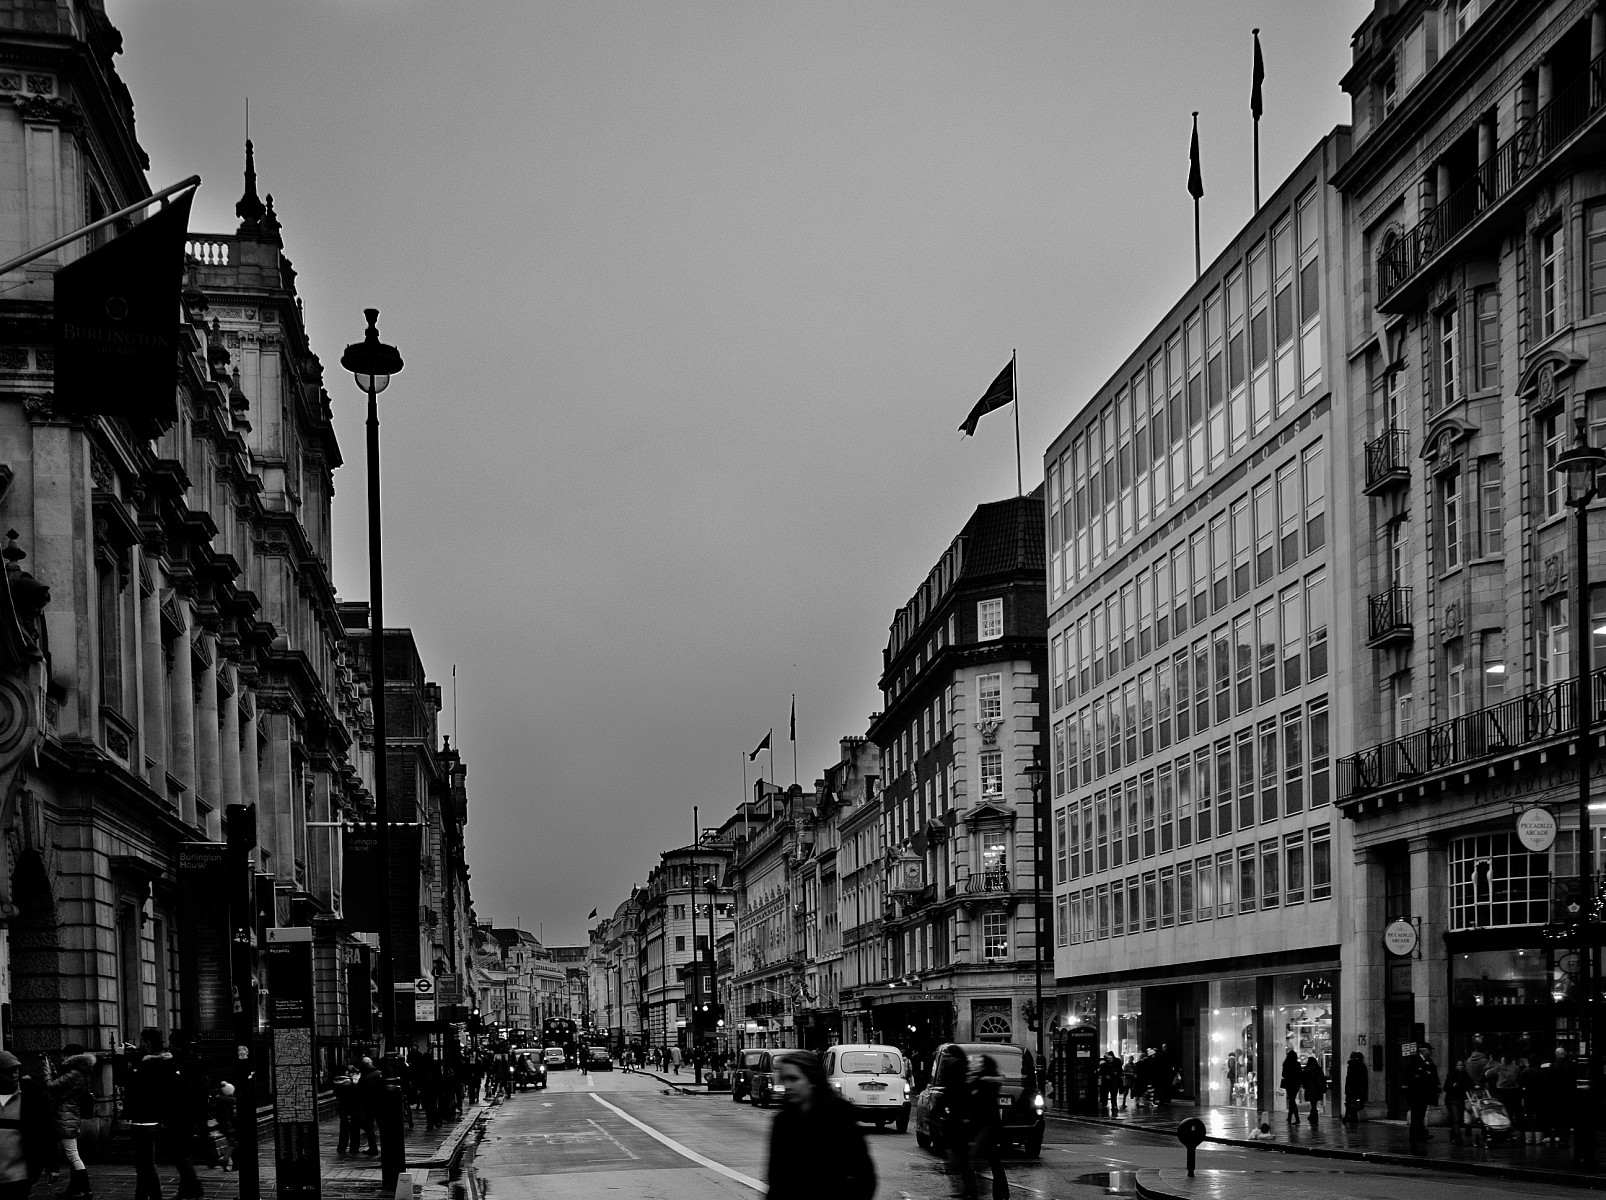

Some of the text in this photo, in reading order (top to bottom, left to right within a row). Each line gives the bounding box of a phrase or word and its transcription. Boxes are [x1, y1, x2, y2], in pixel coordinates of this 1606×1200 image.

[64, 322, 168, 348] BURLINGTON
[1474, 767, 1577, 805] PICCADILLY
[179, 852, 222, 863] Burlington
[179, 861, 207, 869] House
